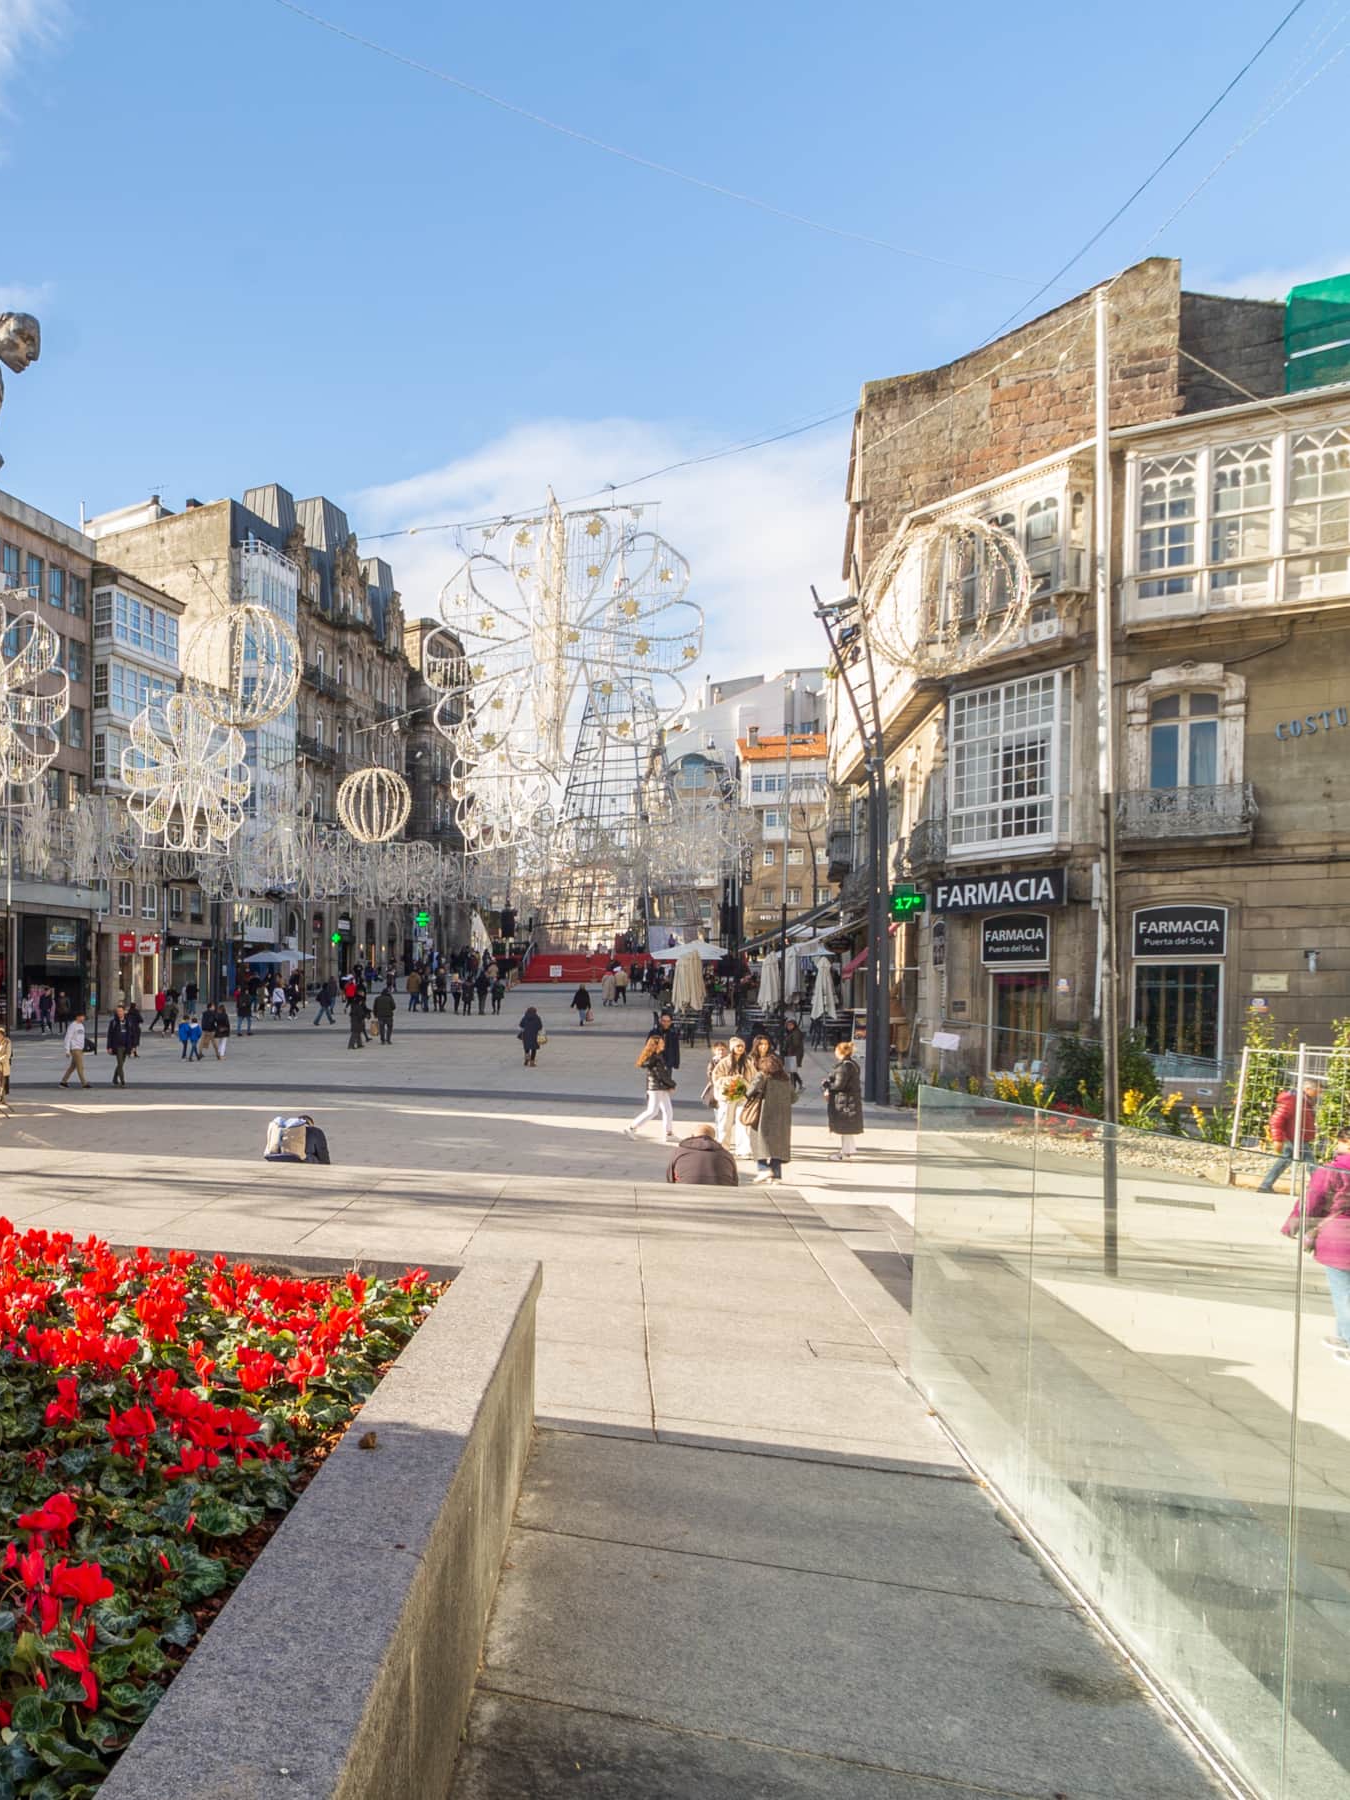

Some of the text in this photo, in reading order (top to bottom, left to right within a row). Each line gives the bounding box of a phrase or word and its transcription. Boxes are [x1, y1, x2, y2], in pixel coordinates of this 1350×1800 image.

[1275, 704, 1347, 741] COSTU
[937, 877, 1055, 908] FARMACIA
[985, 927, 1044, 942] FARMACIA
[1139, 920, 1220, 934] FARMACIA
[1144, 938, 1173, 946] Puerta
[1175, 937, 1188, 945] del
[1190, 936, 1207, 947] Sol,
